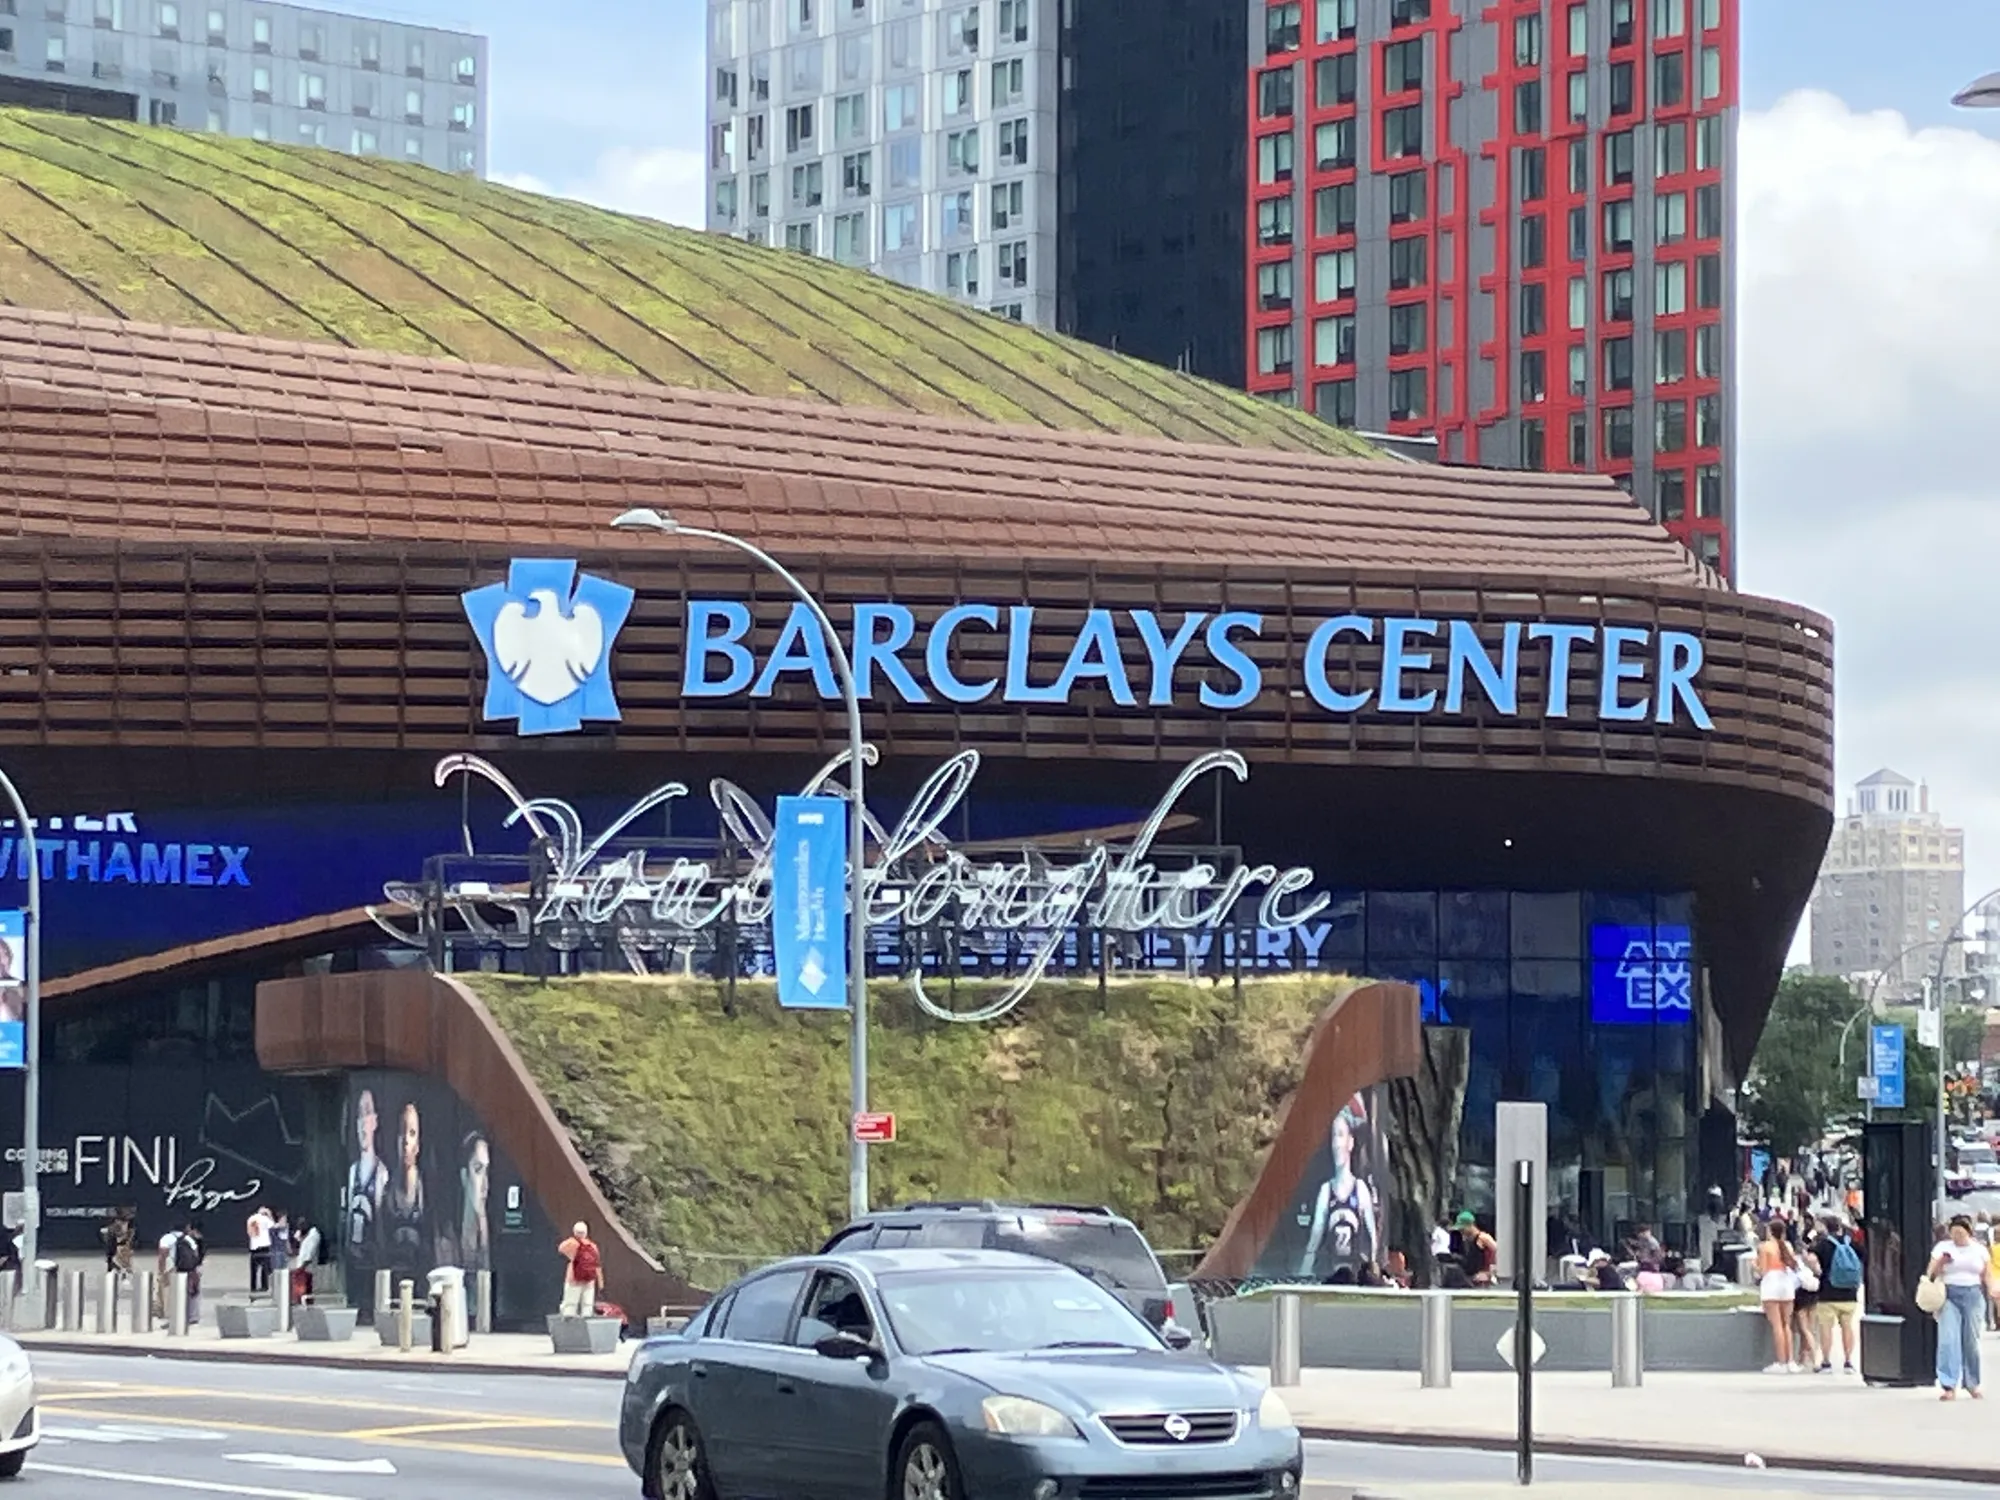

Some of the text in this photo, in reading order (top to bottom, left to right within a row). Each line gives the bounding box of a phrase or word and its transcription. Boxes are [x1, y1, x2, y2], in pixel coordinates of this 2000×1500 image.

[681, 600, 1715, 731] BARCLAYS CENTER
[74, 1135, 176, 1186] FINI
